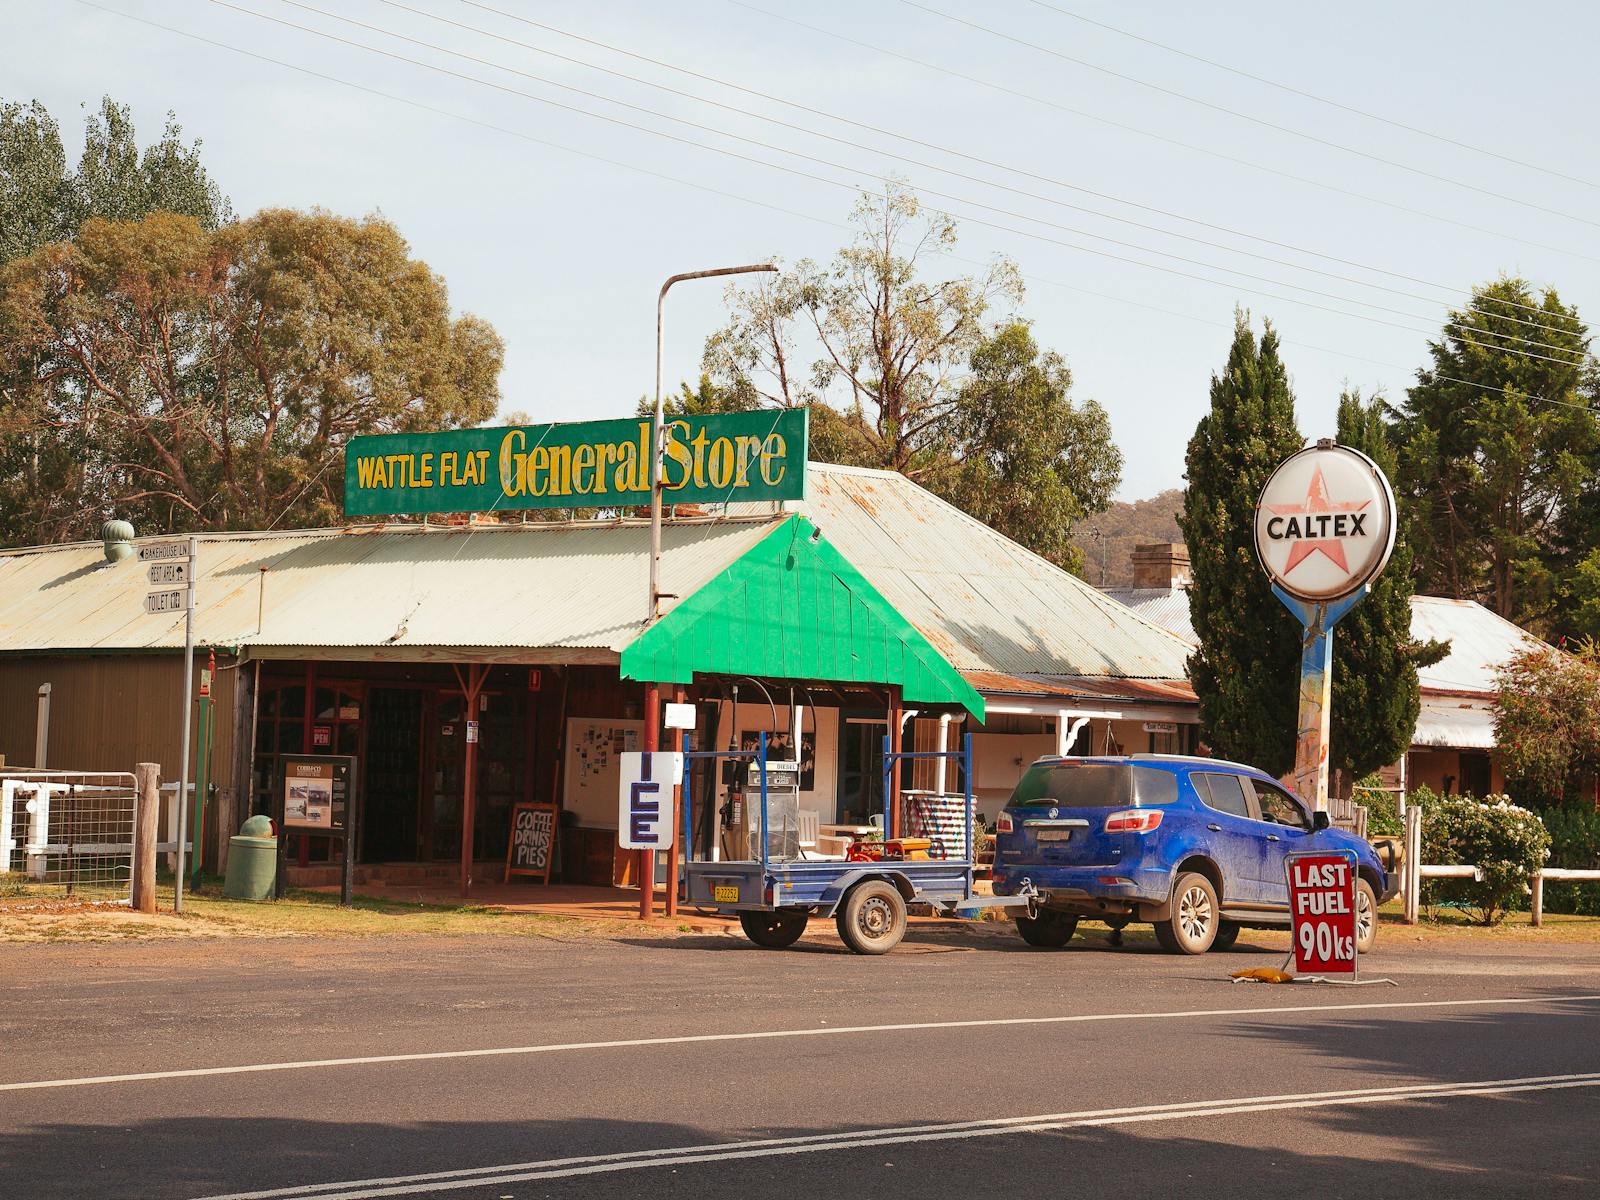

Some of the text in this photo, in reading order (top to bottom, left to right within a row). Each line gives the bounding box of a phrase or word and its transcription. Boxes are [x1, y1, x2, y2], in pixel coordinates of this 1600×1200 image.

[357, 419, 787, 497] WATTLE FLAT General Store
[1266, 513, 1367, 540] CALTEX
[144, 544, 187, 559] BAKEHOUSE LN
[151, 565, 175, 582] REST AREA
[148, 594, 168, 611] TOILET
[313, 733, 329, 744] PEN
[630, 752, 660, 843] ICE
[514, 829, 551, 849] DRINKS
[517, 845, 548, 868] PIES
[1294, 863, 1348, 888] LAST
[1297, 891, 1350, 915] FUEL
